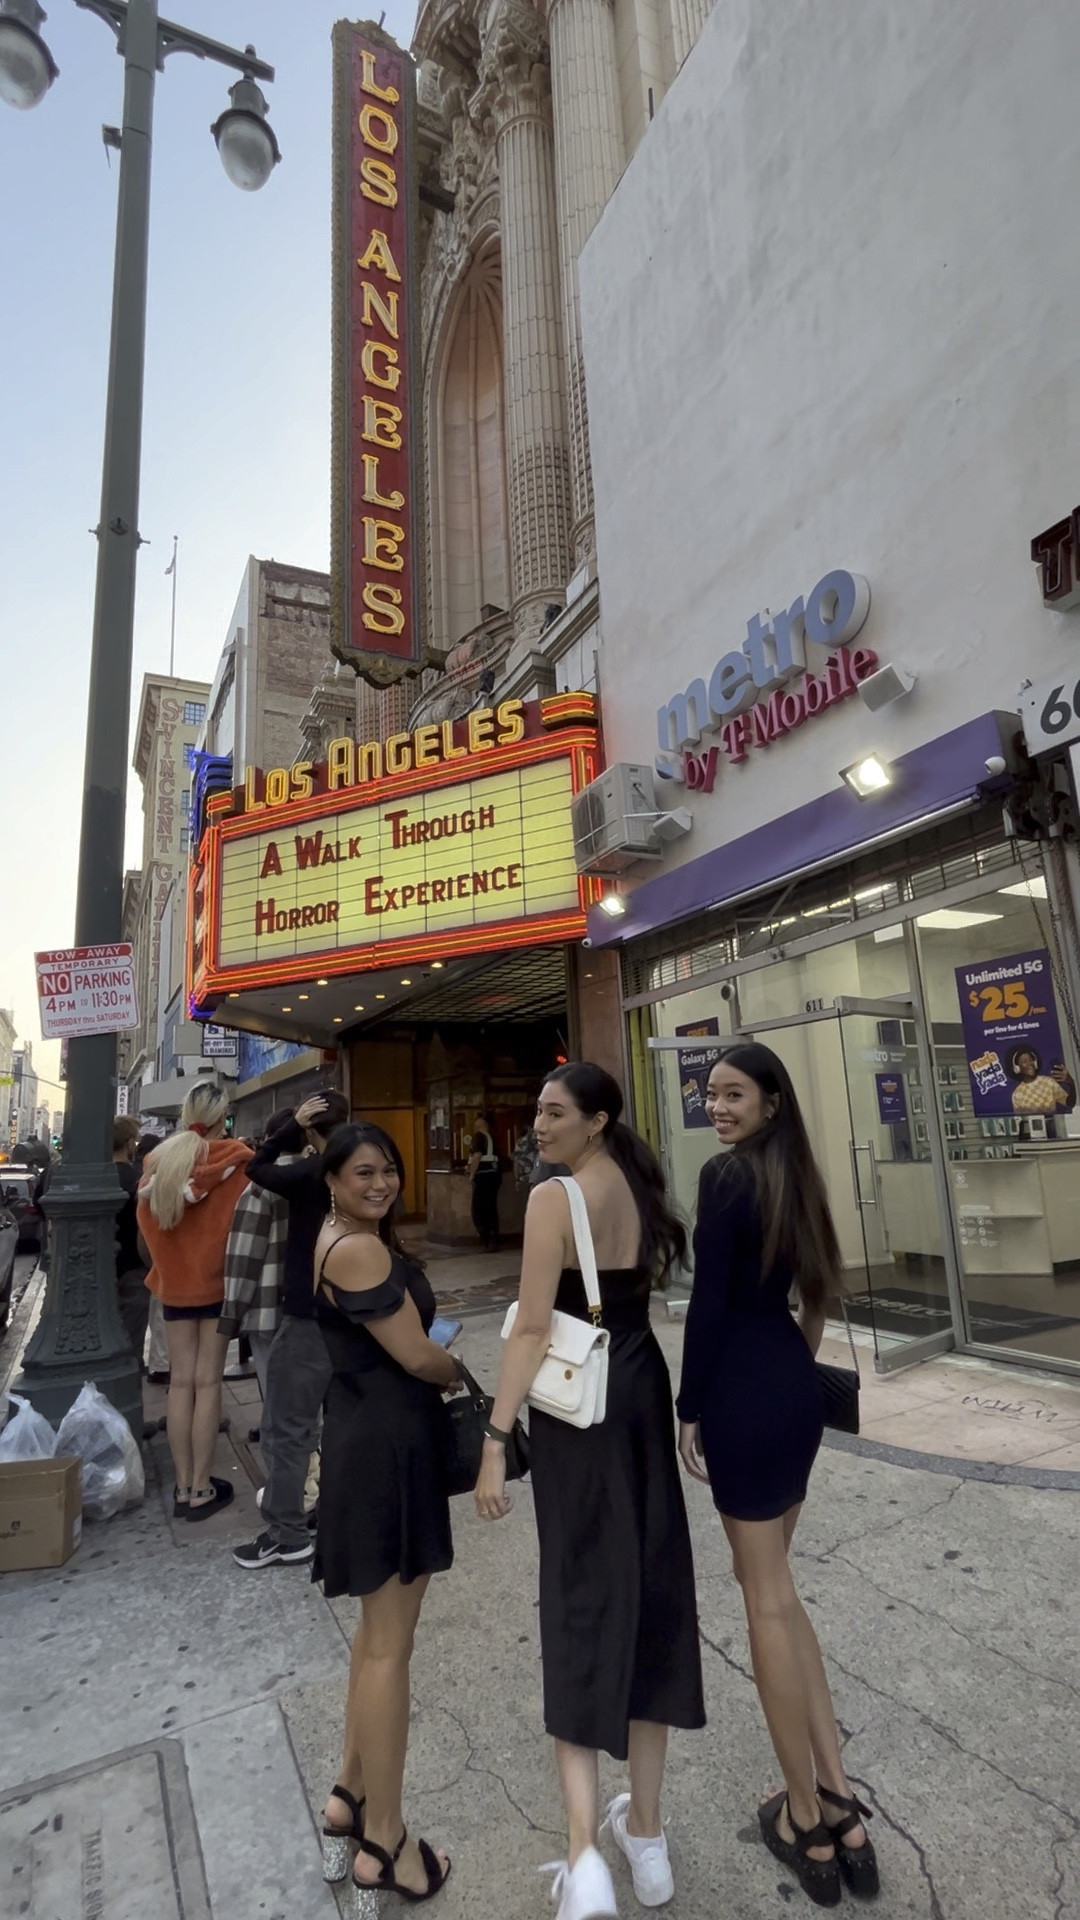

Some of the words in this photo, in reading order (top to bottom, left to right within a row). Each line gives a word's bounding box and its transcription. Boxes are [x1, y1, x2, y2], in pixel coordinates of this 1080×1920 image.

[360, 50, 399, 209] LOS
[357, 228, 404, 636] ANGELES
[1031, 505, 1080, 603] T
[657, 568, 872, 752] metro
[244, 760, 313, 813] LOS
[327, 698, 525, 790] ANGELES
[683, 745, 720, 793] by
[156, 722, 177, 853] VINCENT
[260, 842, 283, 879] A
[294, 830, 362, 871] WALK
[384, 804, 496, 850] THROUGH
[254, 897, 340, 936] HORROR
[364, 863, 522, 916] EXPERIENCE
[42, 973, 70, 995] NO
[74, 970, 131, 991] PARKING
[51, 958, 119, 971] TEMPORARY
[965, 963, 1022, 986] Unlimited
[1024, 959, 1043, 974] 5G
[47, 1016, 82, 1028] THURSDAY
[96, 1011, 130, 1023] SATURDAY
[805, 998, 823, 1012] 611
[681, 1053, 705, 1066] Galaxy
[706, 1049, 718, 1061] 5G
[975, 1062, 1002, 1082] yada
[119, 1086, 127, 1114] PARKI
